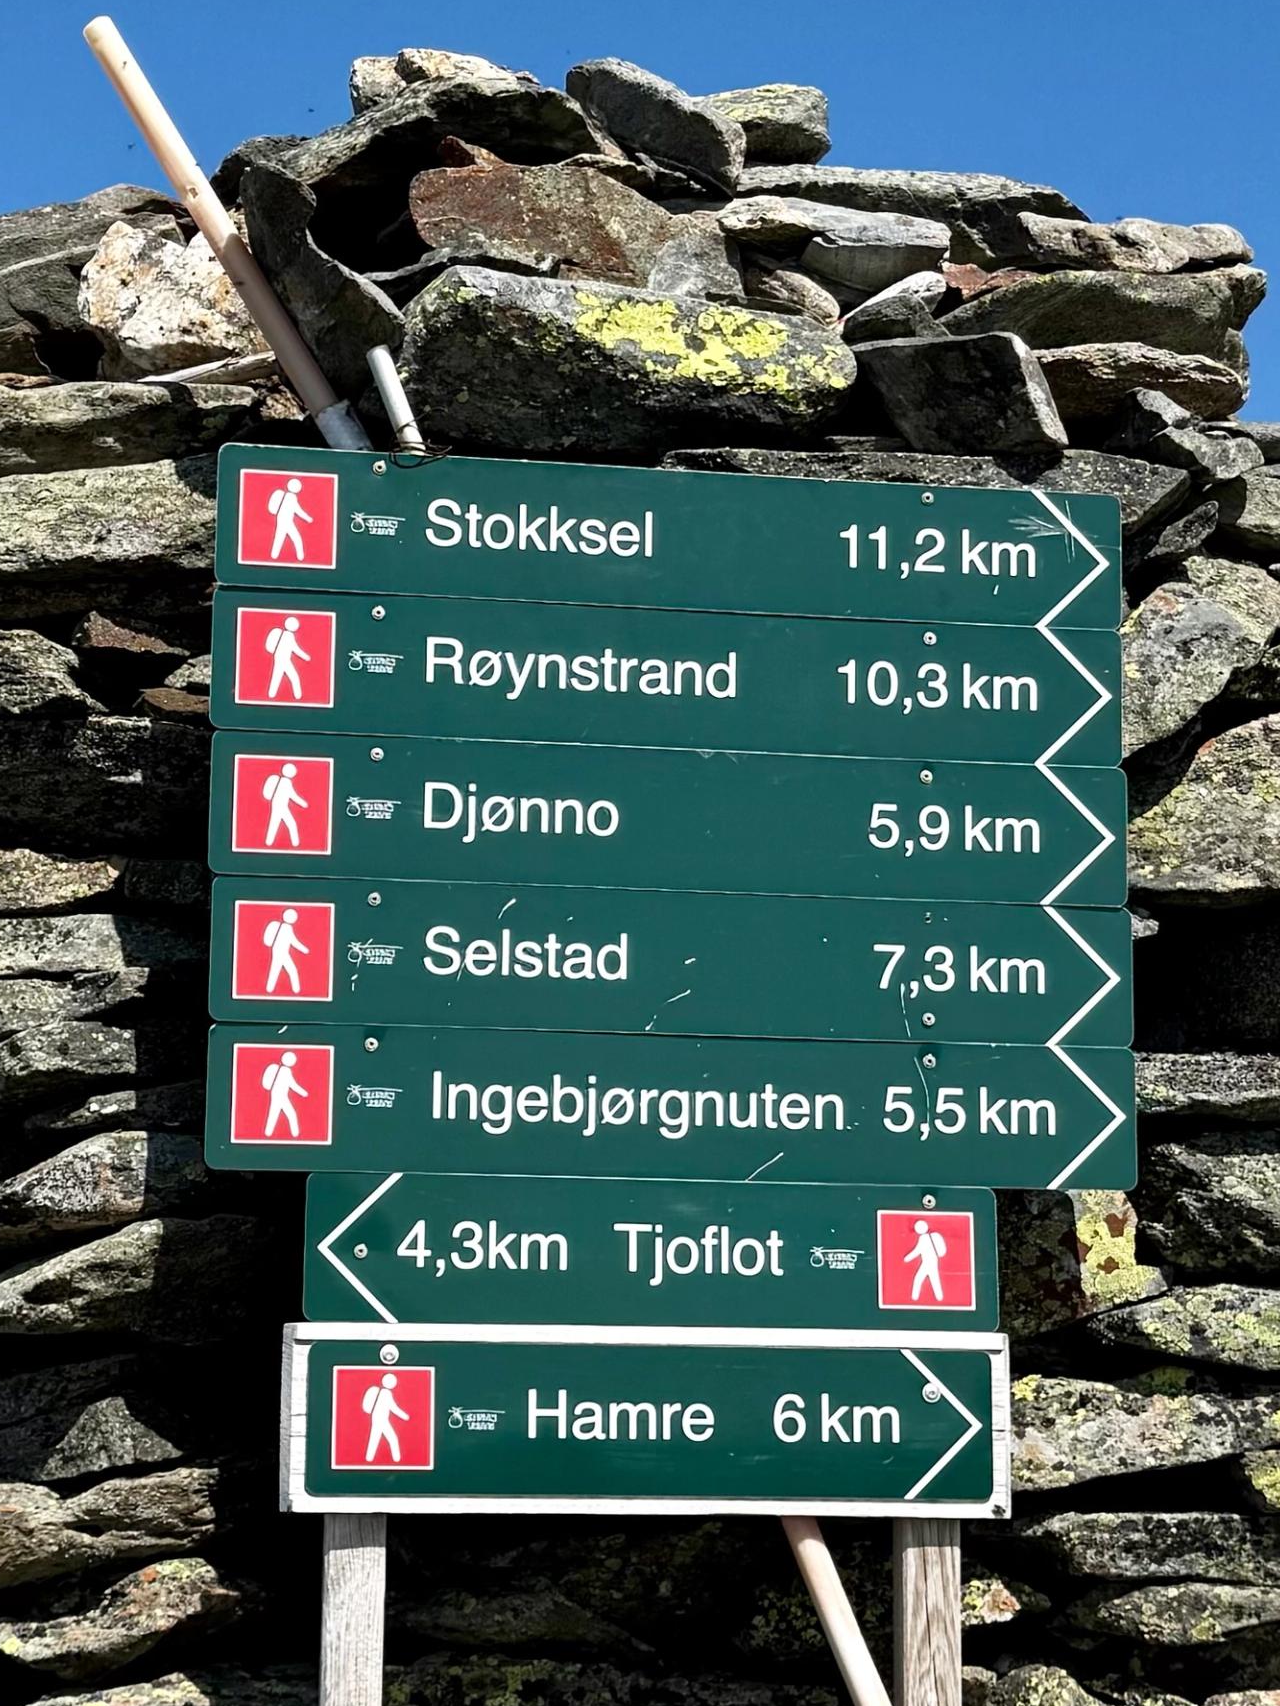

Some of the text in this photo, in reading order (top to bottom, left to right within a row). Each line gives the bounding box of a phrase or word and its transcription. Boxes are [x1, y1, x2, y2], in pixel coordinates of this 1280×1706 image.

[425, 498, 1037, 580] Stokksel 11,2 km
[425, 636, 1038, 715] Røynstrand 10,3 km
[423, 781, 1041, 858] Djønno 5,9 km
[423, 925, 1046, 999] Selstad 7,3 km
[432, 1070, 1057, 1141] Ingebjørgnuten 5,5 km
[613, 1223, 784, 1287] Tjoflot
[527, 1388, 901, 1444] Hamre 6 km
